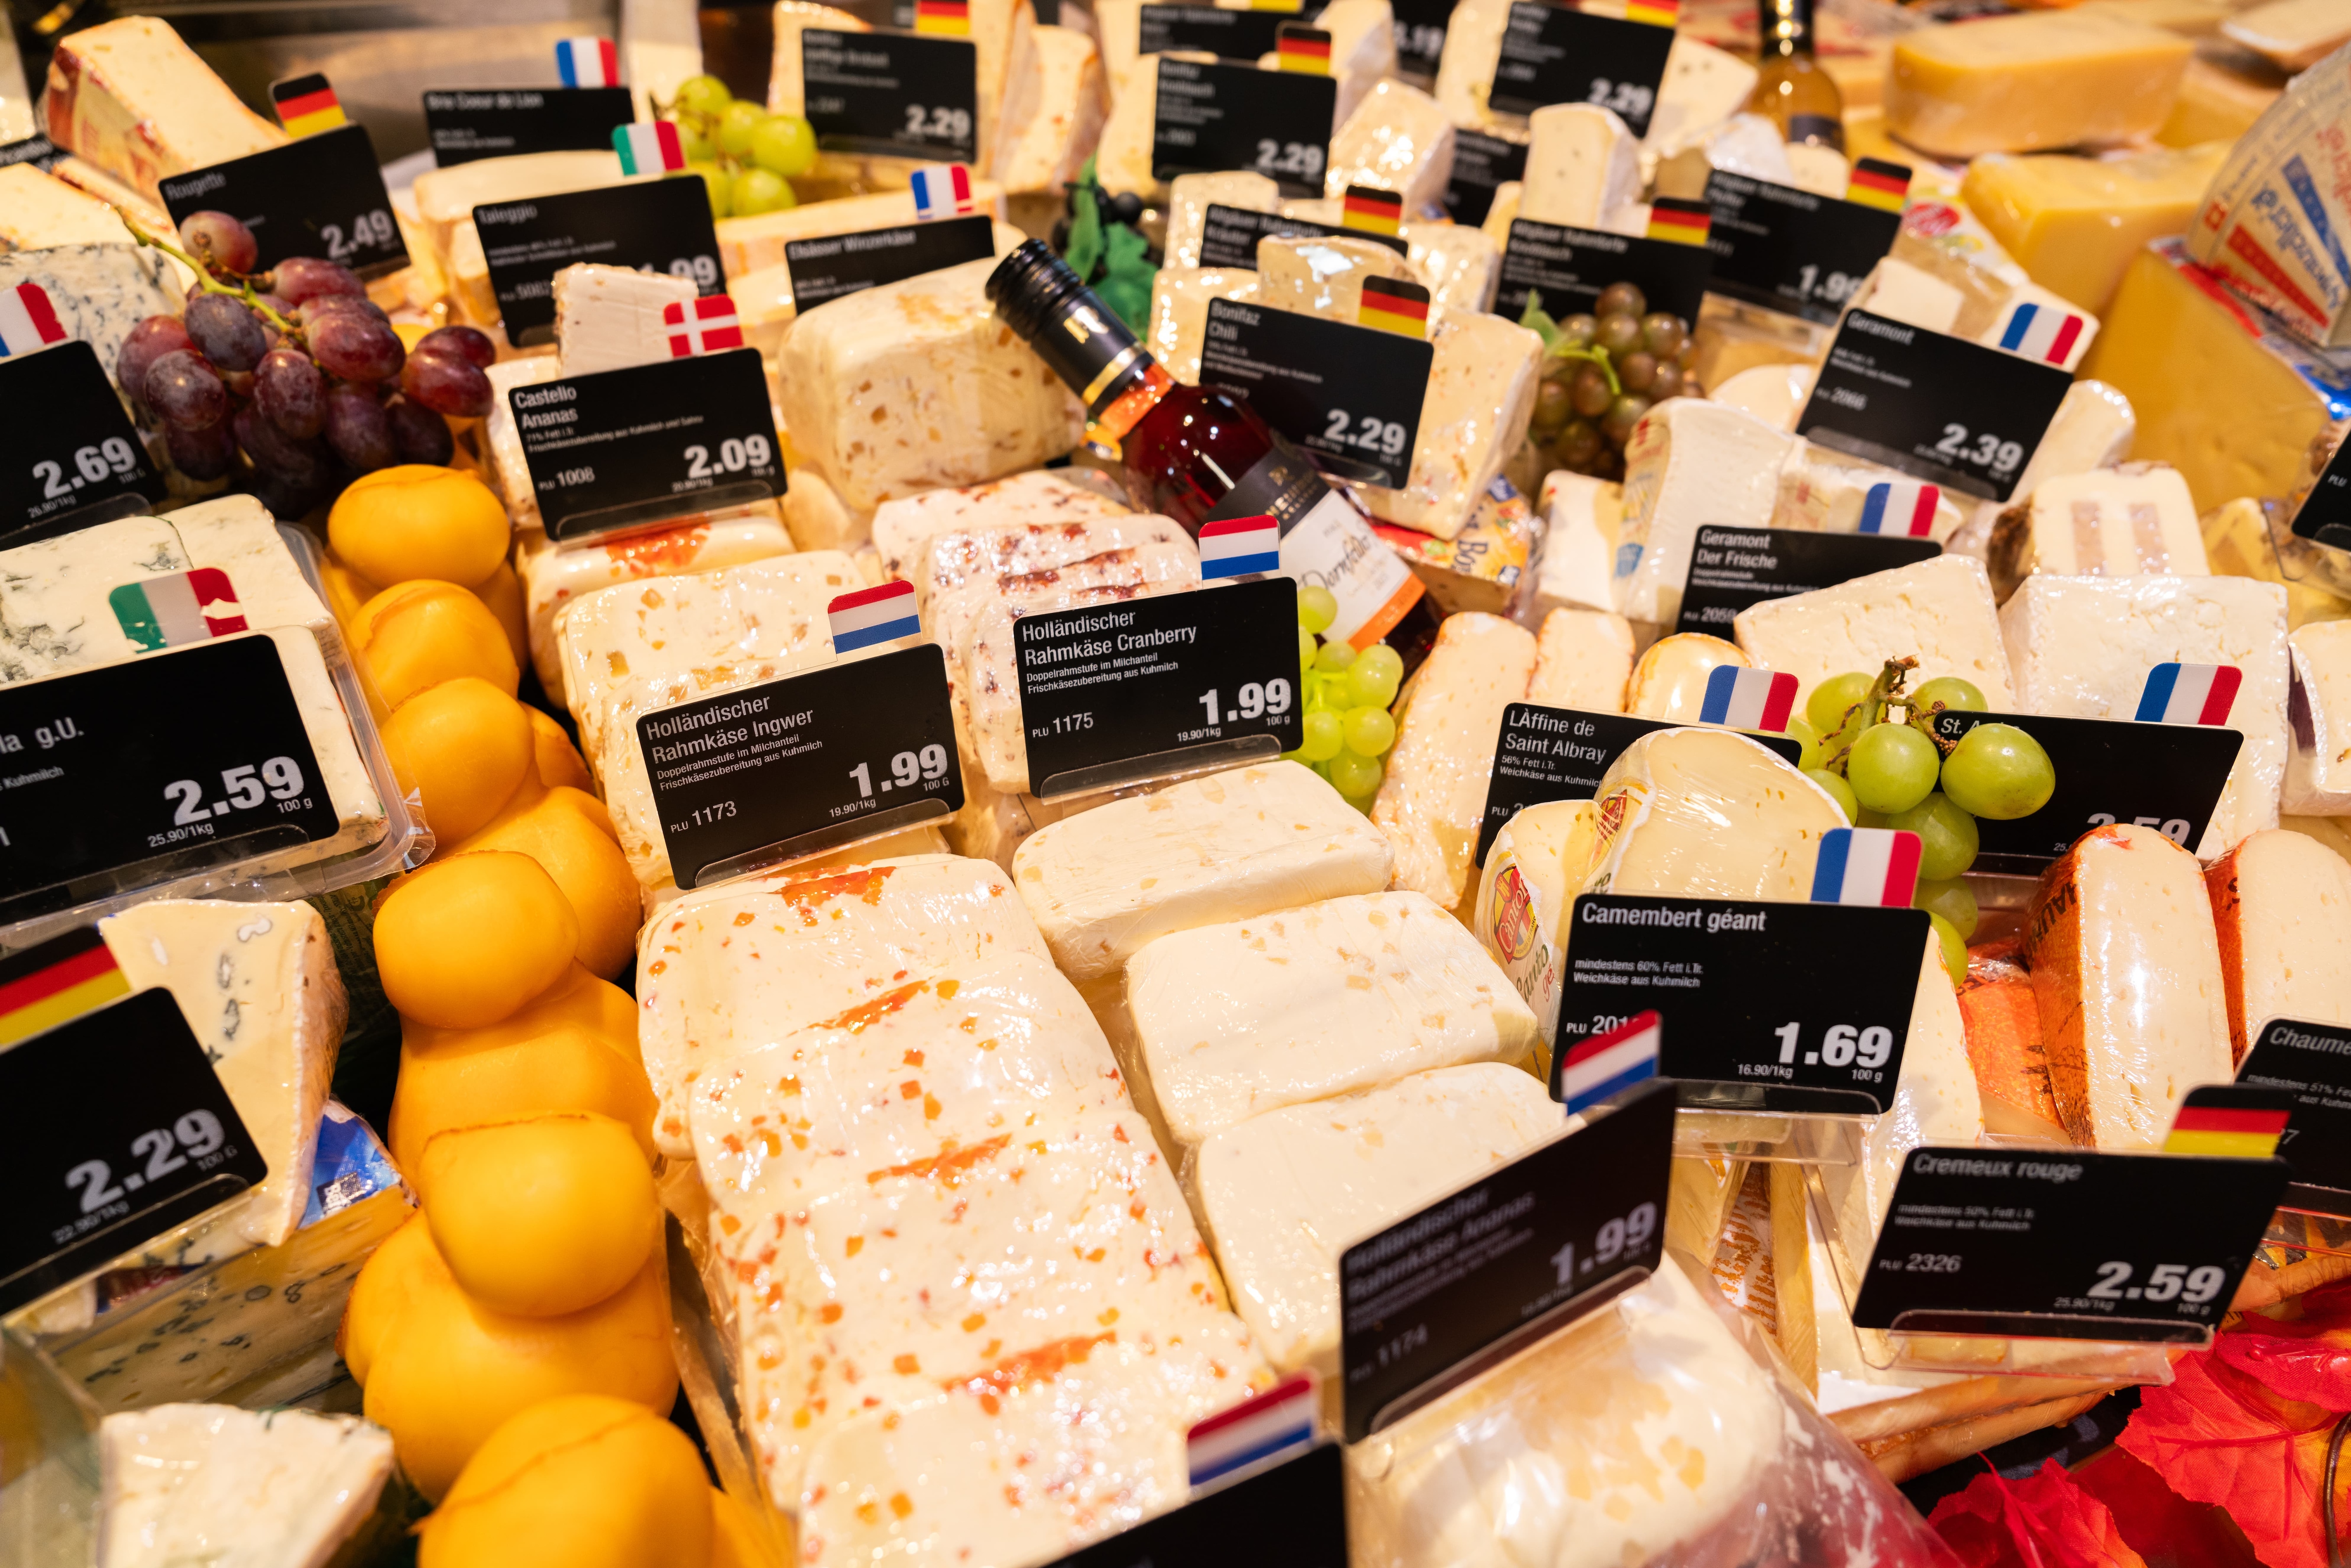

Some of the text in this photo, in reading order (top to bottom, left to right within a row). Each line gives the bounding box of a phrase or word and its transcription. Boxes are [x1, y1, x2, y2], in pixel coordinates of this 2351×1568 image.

[906, 105, 970, 139] 2.29
[1254, 140, 1323, 176] 2.29
[322, 210, 392, 259] 2.49
[1211, 301, 1260, 325] Bonifaz
[1208, 321, 1238, 340] Chili
[1848, 313, 1914, 344] Geramont
[515, 386, 576, 408] Castello
[522, 409, 578, 428] Ananas
[1322, 410, 1405, 455] 2.29
[685, 435, 770, 482] 2.09
[1932, 424, 2022, 473] 2.39
[33, 438, 135, 499] 2.69
[538, 467, 594, 489] PLU 1008
[2328, 473, 2347, 487] PLU
[1701, 529, 1770, 549] Geramont
[1697, 549, 1777, 568] Der Frische
[1023, 612, 1136, 641] Holländischer
[1025, 627, 1196, 666] Rahmkäse Cranberry
[1027, 663, 1098, 682] Doppelrahmstufe
[1113, 653, 1157, 668] Milchanteil
[1028, 672, 1121, 693] Frischkäsezubereitung
[1141, 662, 1178, 675] Kuhmilch
[646, 697, 769, 740] Holländischer
[1199, 678, 1291, 729] 1.99
[36, 717, 83, 749] g.U.
[652, 710, 813, 764] Rahmkäse Ingwer
[1033, 712, 1093, 737] PLU 1175
[1177, 716, 1290, 741] 19.90/1kg 100 g
[1574, 720, 1594, 736] de
[1941, 718, 1962, 734] St.
[657, 753, 734, 779] Doppelrahmstufe
[751, 734, 799, 754] Milchanteil
[1502, 755, 1520, 764] 56%
[1523, 758, 1539, 767] Fett
[1506, 733, 1606, 764] Saint Albray
[4, 765, 64, 789] Kuhmilch
[660, 741, 822, 790] Frischkäsezubereitung aus Kuhmilch
[850, 744, 947, 803] 1.99
[1500, 766, 1545, 780] Weichkäse
[165, 756, 304, 826] 2.59
[829, 777, 949, 817] 19.90/1kg 100 G
[148, 798, 312, 847] 25.90/1kg 100 g
[671, 801, 736, 833] PLU 1173
[1491, 807, 1508, 816] PLU
[1495, 877, 1529, 952] Cantor
[1583, 903, 1766, 933] Camembert géant
[1574, 972, 1700, 987] Weichkäse aus Kuhmilch
[1575, 959, 1635, 971] mindestens
[1637, 961, 1660, 971] 60%
[1663, 962, 1683, 973] Fett
[1566, 1023, 1587, 1033] PLU
[2269, 1026, 2351, 1056] Chaume
[1772, 1022, 1893, 1070] 1.69
[1738, 1064, 1883, 1083] 16.90/1kg 100 g
[2298, 1095, 2319, 1104] aus
[66, 1110, 223, 1213] 2.29
[1914, 1154, 2083, 1182] Cremeux rouge
[1551, 1203, 1656, 1292] 1.99
[1906, 1253, 1961, 1272] 2326
[2087, 1261, 2225, 1304] 2.59
[2054, 1297, 2114, 1311] 25.90/1kg
[1379, 1324, 1427, 1365] 1174
